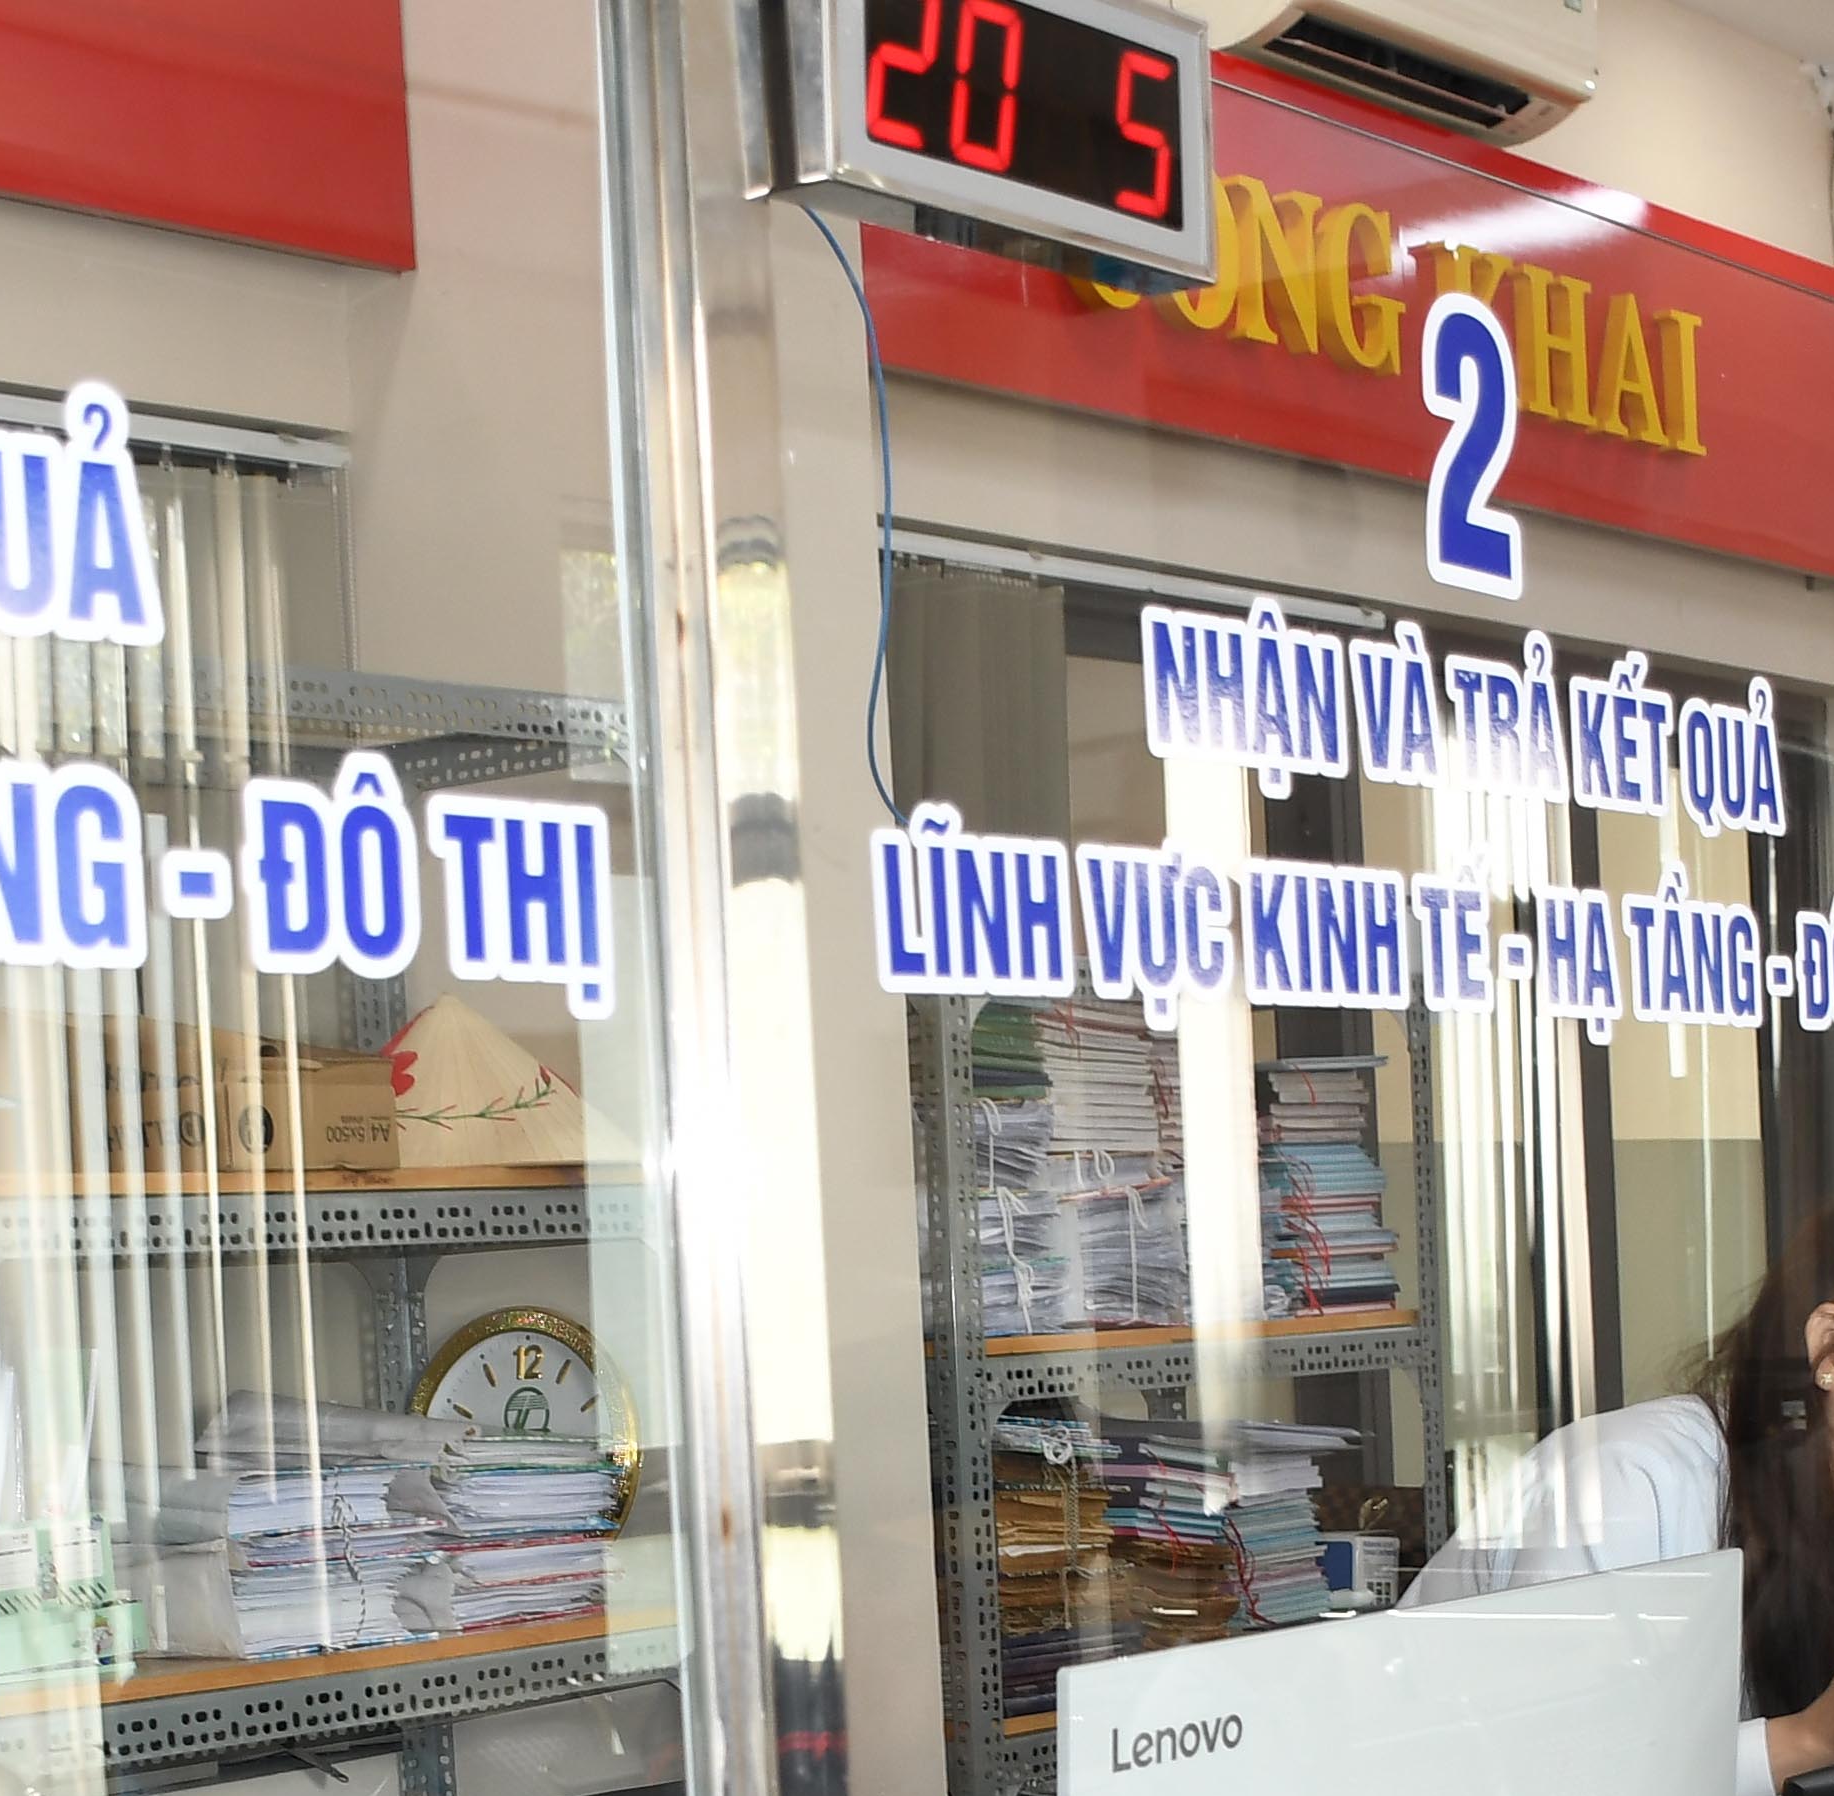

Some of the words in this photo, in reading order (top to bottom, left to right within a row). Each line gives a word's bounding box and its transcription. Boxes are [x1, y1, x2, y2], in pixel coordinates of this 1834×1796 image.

[866, 0, 1024, 173] 20
[1114, 50, 1173, 221] 5
[1433, 311, 1518, 580] 2
[1152, 610, 1339, 784] NHẬN
[1357, 632, 1436, 777] VÀ
[1453, 642, 1561, 792] TRẢ
[1577, 662, 1669, 807] KẾT
[1685, 688, 1780, 828] QUẢ
[180, 871, 214, 895] -
[259, 772, 405, 958] ĐÔ
[443, 814, 602, 1004] THỊ
[884, 817, 1064, 980] LĨNH
[1087, 850, 1223, 1013] VỰC
[1252, 874, 1402, 994] KINH
[1418, 858, 1488, 1001] TẾ
[1547, 902, 1616, 1032] HẠ
[1631, 872, 1757, 1014] TẦNG
[513, 1344, 544, 1381] 12
[1110, 1709, 1243, 1773] Lenovo
